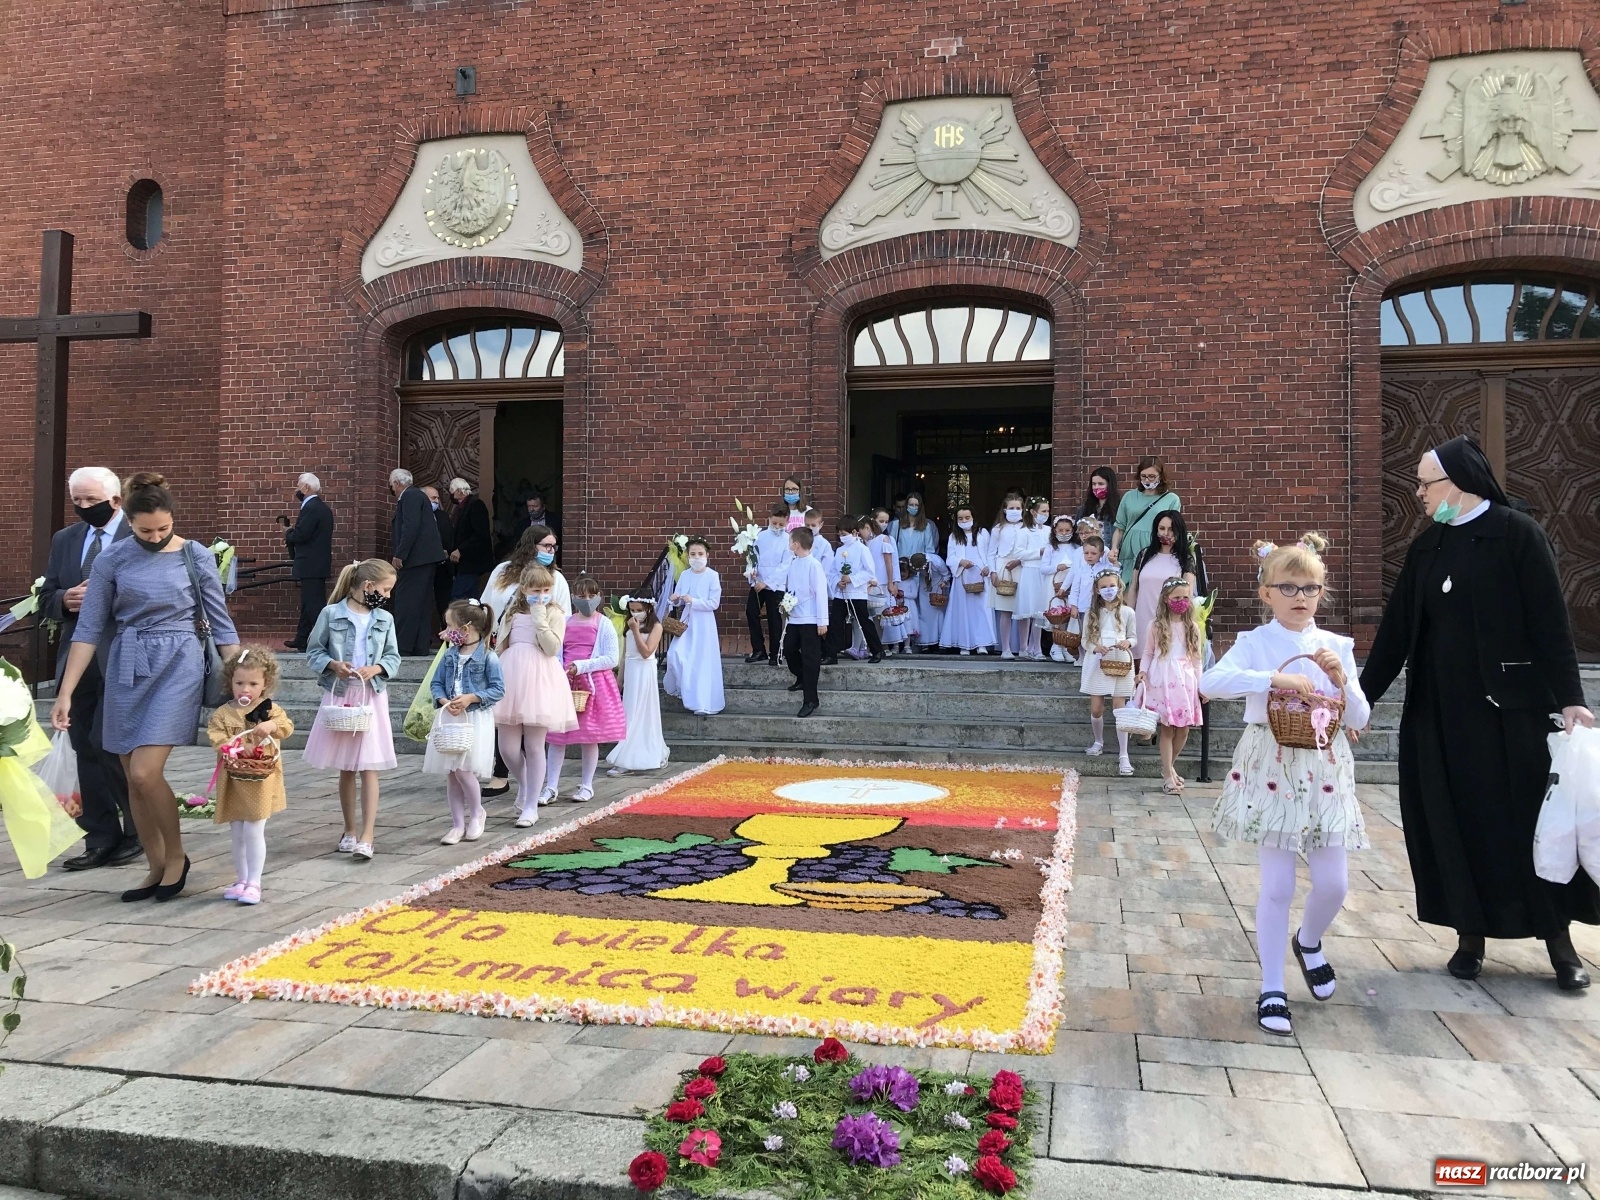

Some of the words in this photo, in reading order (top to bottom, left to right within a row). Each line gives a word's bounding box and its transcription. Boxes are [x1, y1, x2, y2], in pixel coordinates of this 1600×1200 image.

[552, 927, 788, 961] wielka
[307, 937, 699, 994] tajemnica
[735, 976, 986, 1029] wiary
